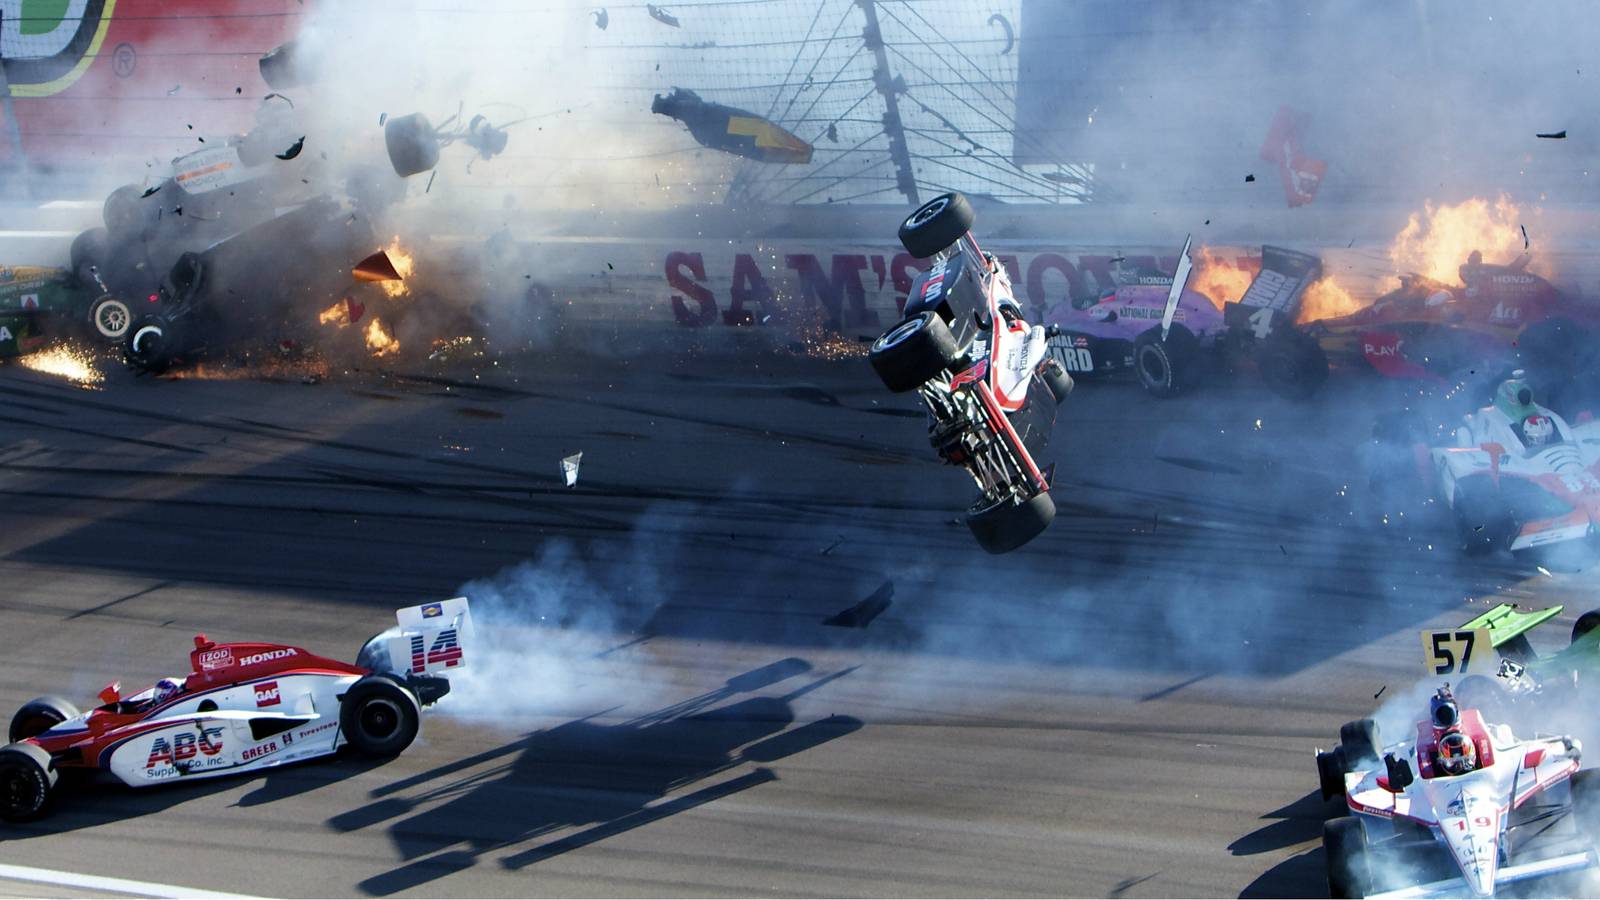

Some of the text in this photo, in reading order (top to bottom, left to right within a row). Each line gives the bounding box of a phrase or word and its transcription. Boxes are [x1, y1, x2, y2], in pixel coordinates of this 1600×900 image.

[1249, 307, 1273, 339] 4
[1045, 347, 1094, 372] ARD
[240, 648, 298, 667] HONDA
[411, 629, 462, 674] 14
[1432, 631, 1475, 675] 57
[255, 689, 280, 702] GAF
[146, 726, 226, 768] ABC
[242, 742, 278, 761] GREER
